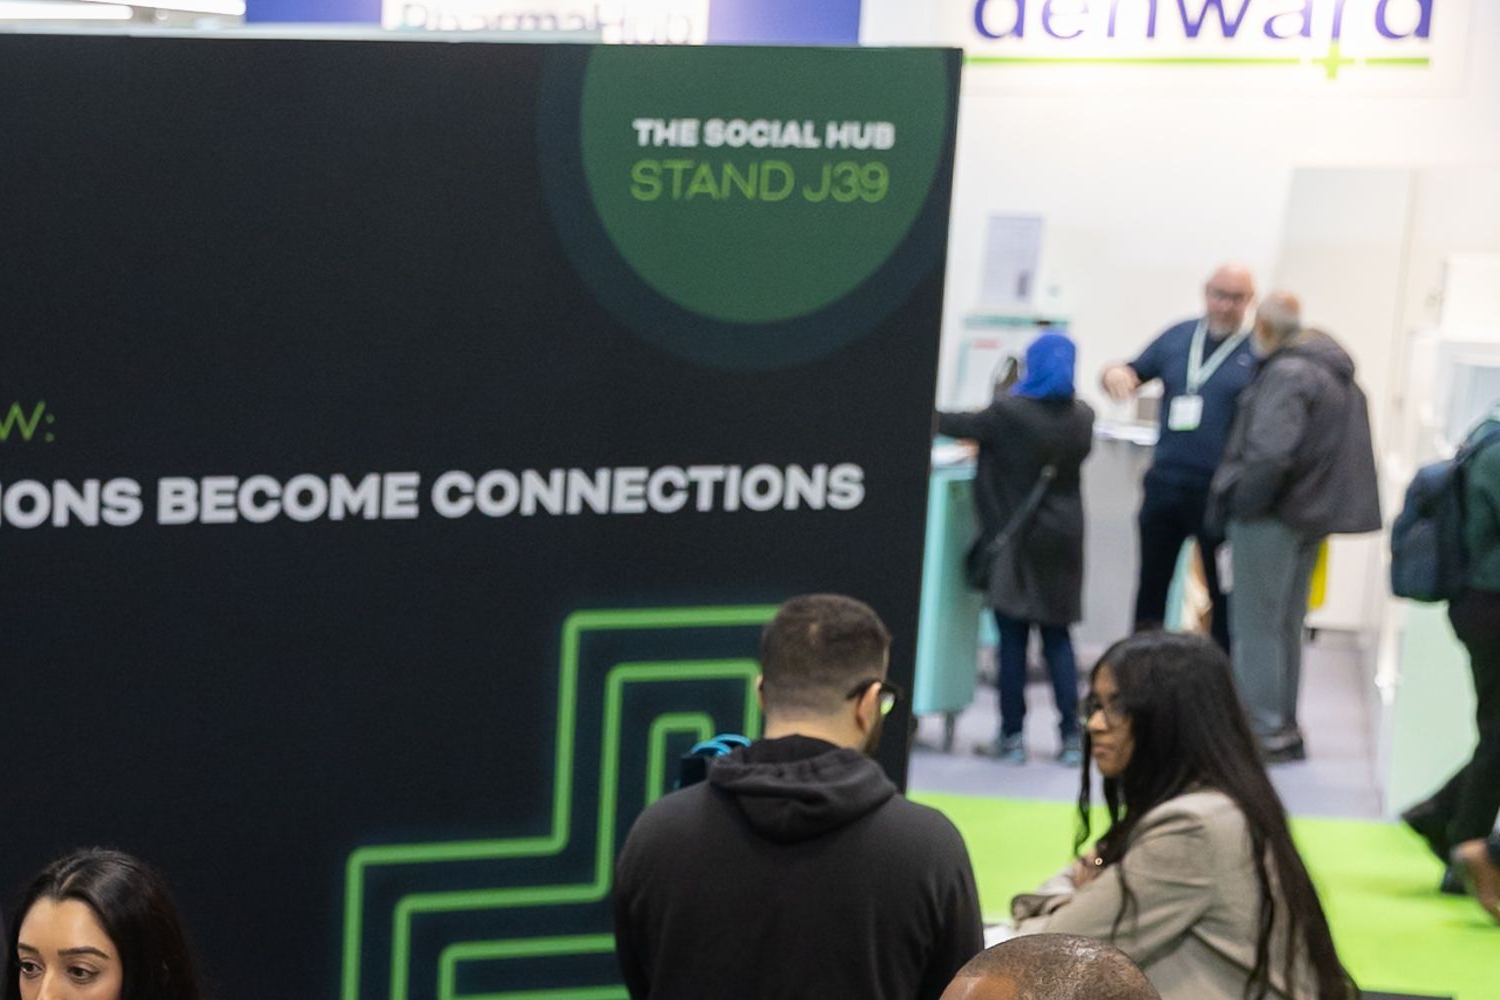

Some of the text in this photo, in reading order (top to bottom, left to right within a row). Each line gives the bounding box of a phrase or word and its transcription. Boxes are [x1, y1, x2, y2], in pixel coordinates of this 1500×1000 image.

[632, 118, 895, 150] THE SOCIAL HUB
[630, 159, 890, 203] STAND J39
[157, 471, 421, 525] BECOME
[431, 463, 866, 519] CONNECTIONS
